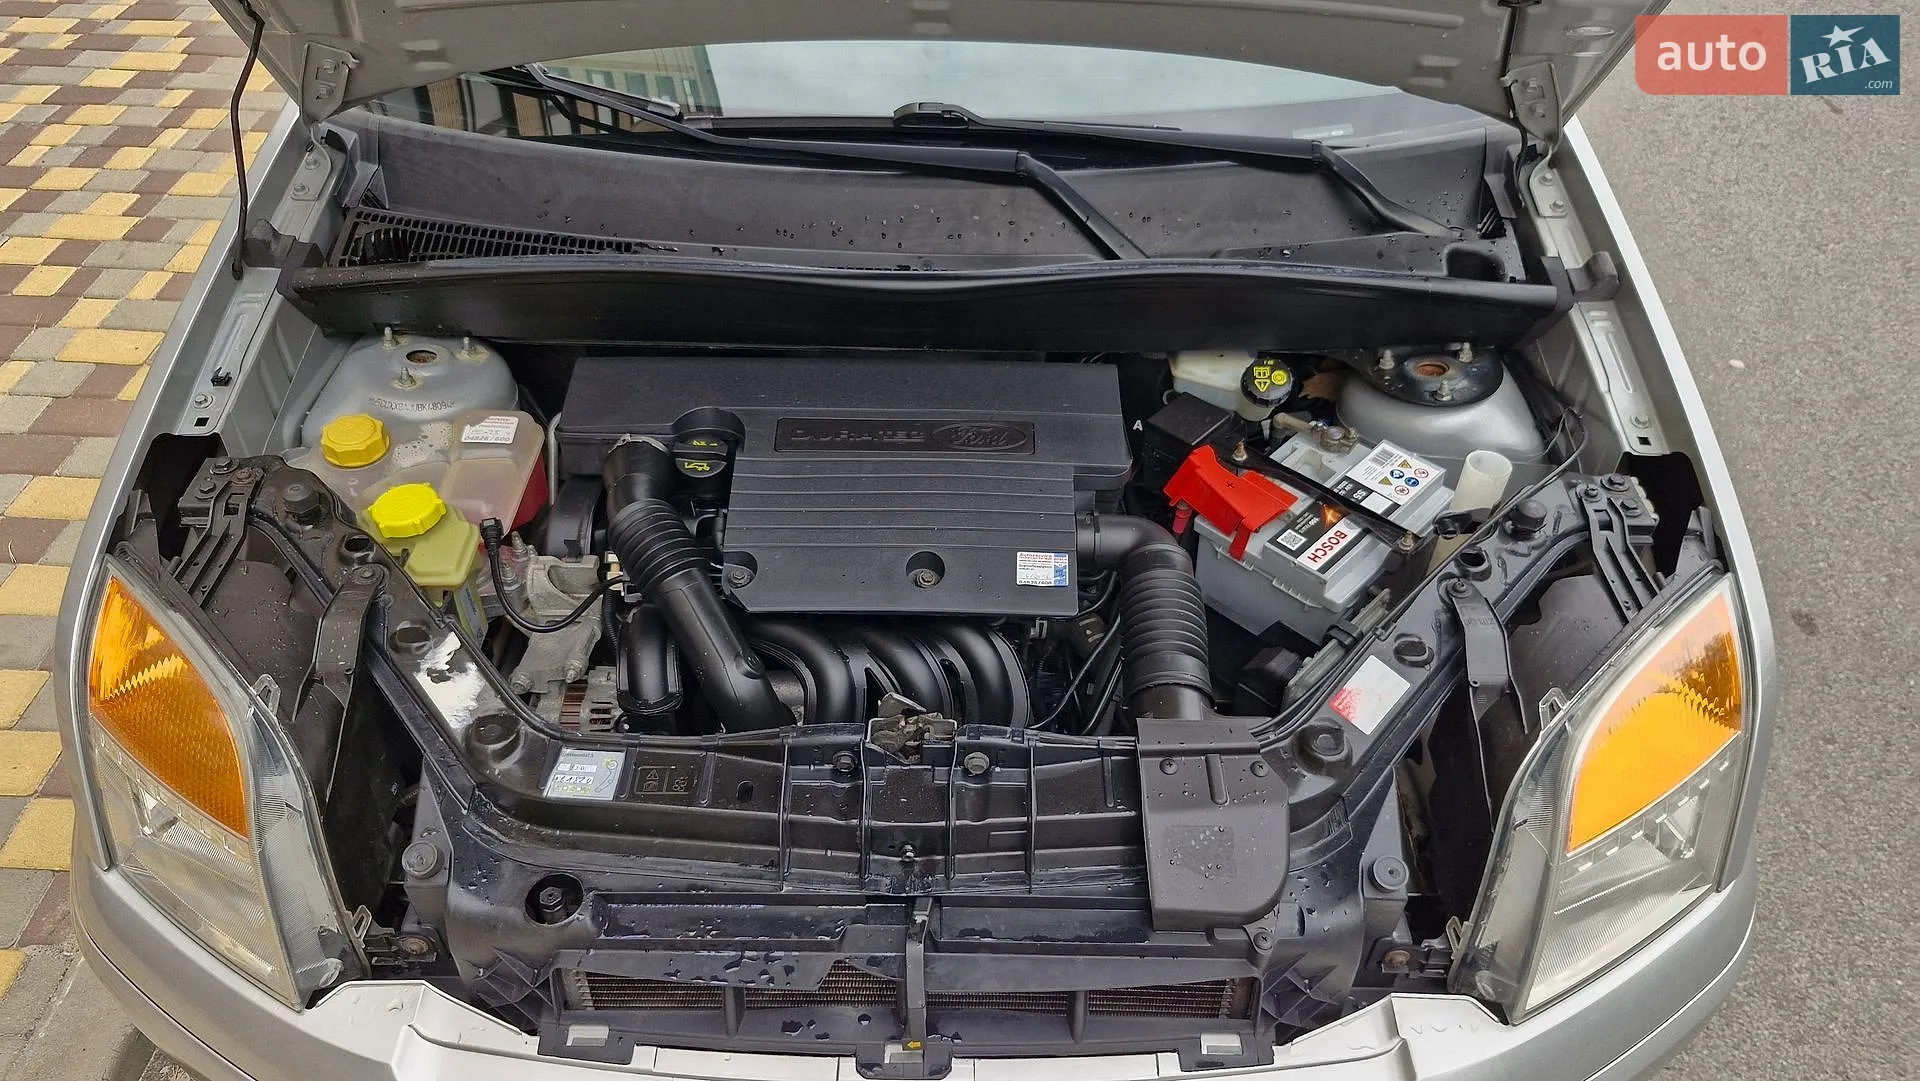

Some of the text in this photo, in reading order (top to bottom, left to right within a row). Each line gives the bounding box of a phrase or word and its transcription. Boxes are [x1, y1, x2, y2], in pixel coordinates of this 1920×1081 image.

[1133, 419, 1143, 431] A
[951, 427, 1009, 446] Ford
[1307, 530, 1348, 563] BOSCH
